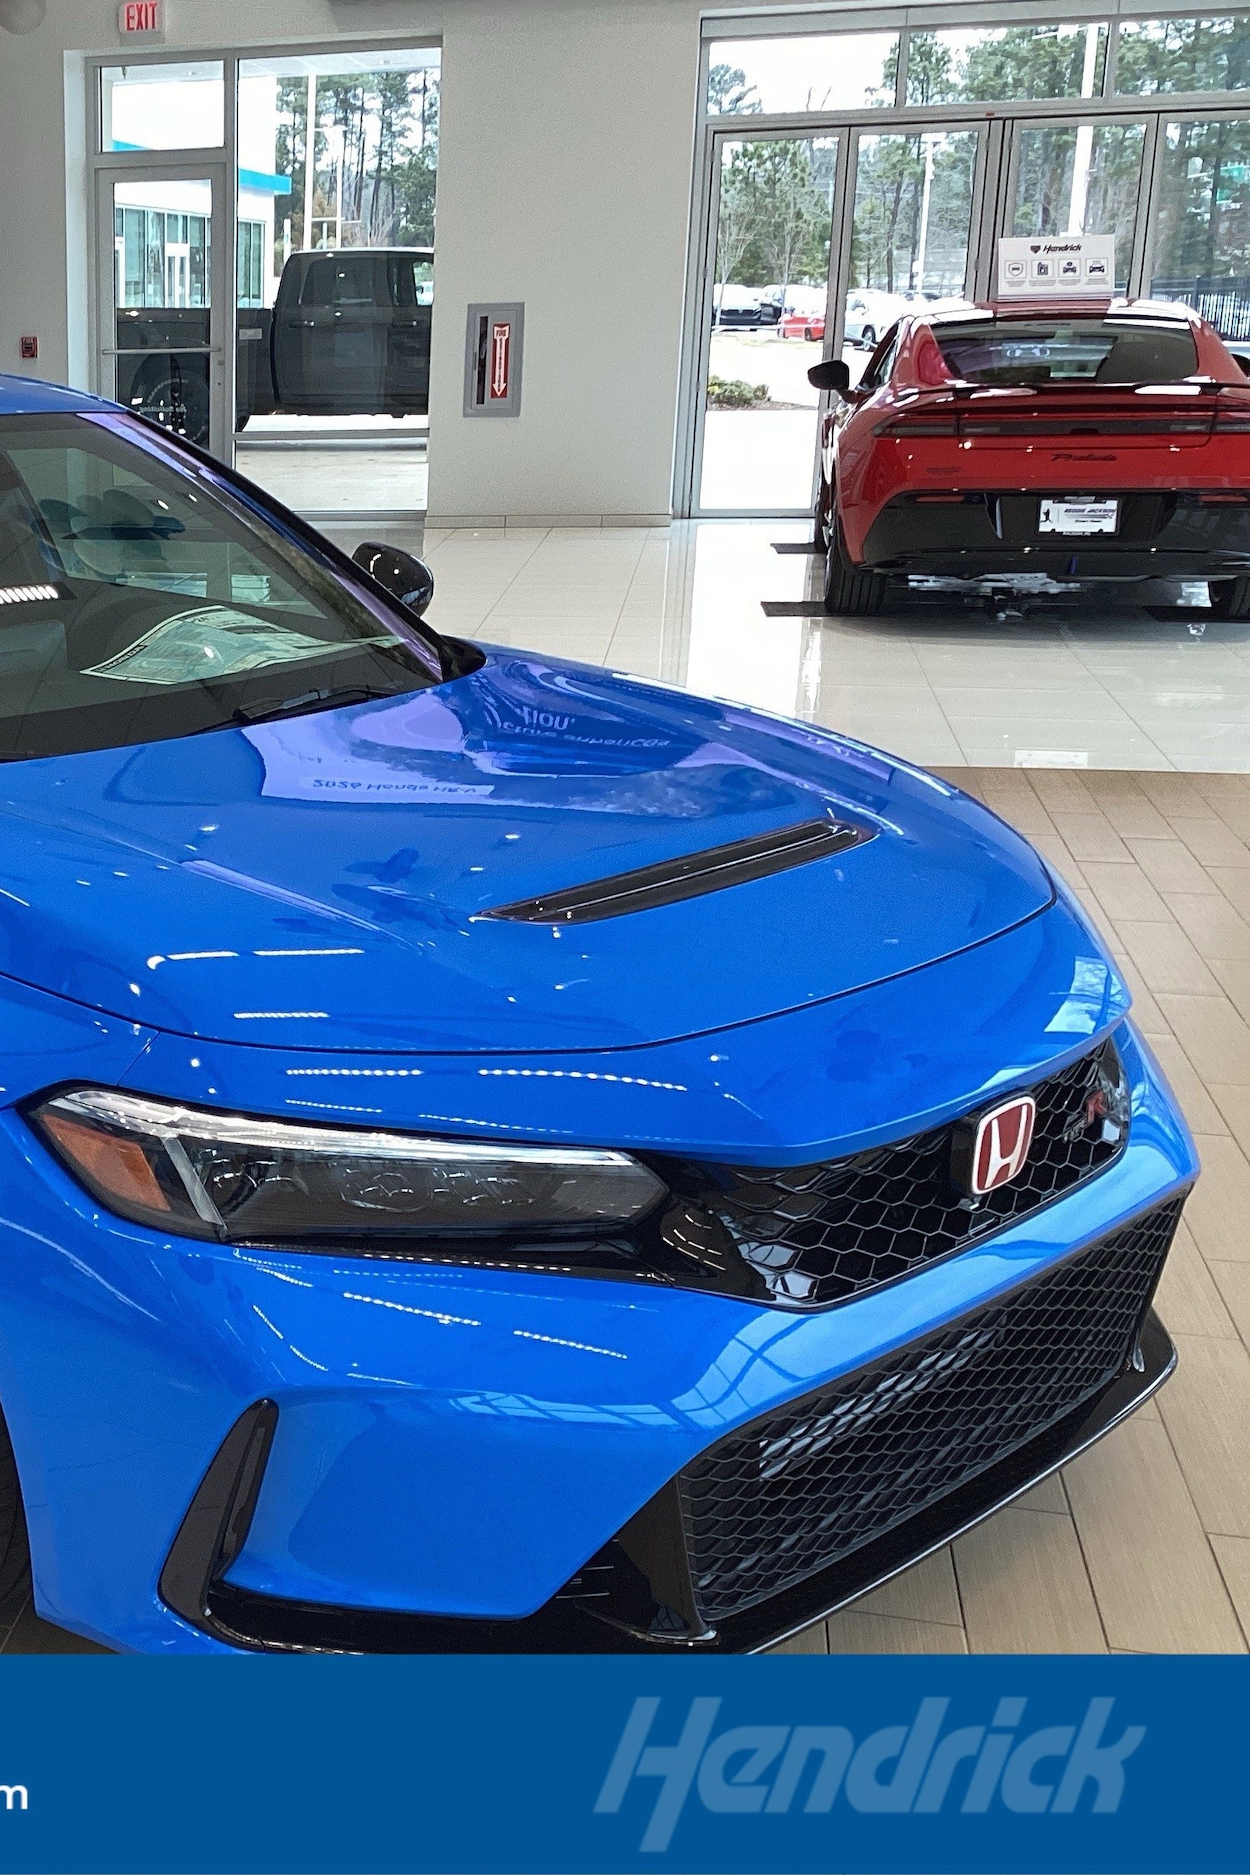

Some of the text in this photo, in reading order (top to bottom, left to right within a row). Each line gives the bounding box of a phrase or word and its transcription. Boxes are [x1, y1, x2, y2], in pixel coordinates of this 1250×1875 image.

[127, 3, 157, 31] EXIT
[1043, 244, 1082, 255] Hendrick
[1051, 453, 1117, 462] Prelude
